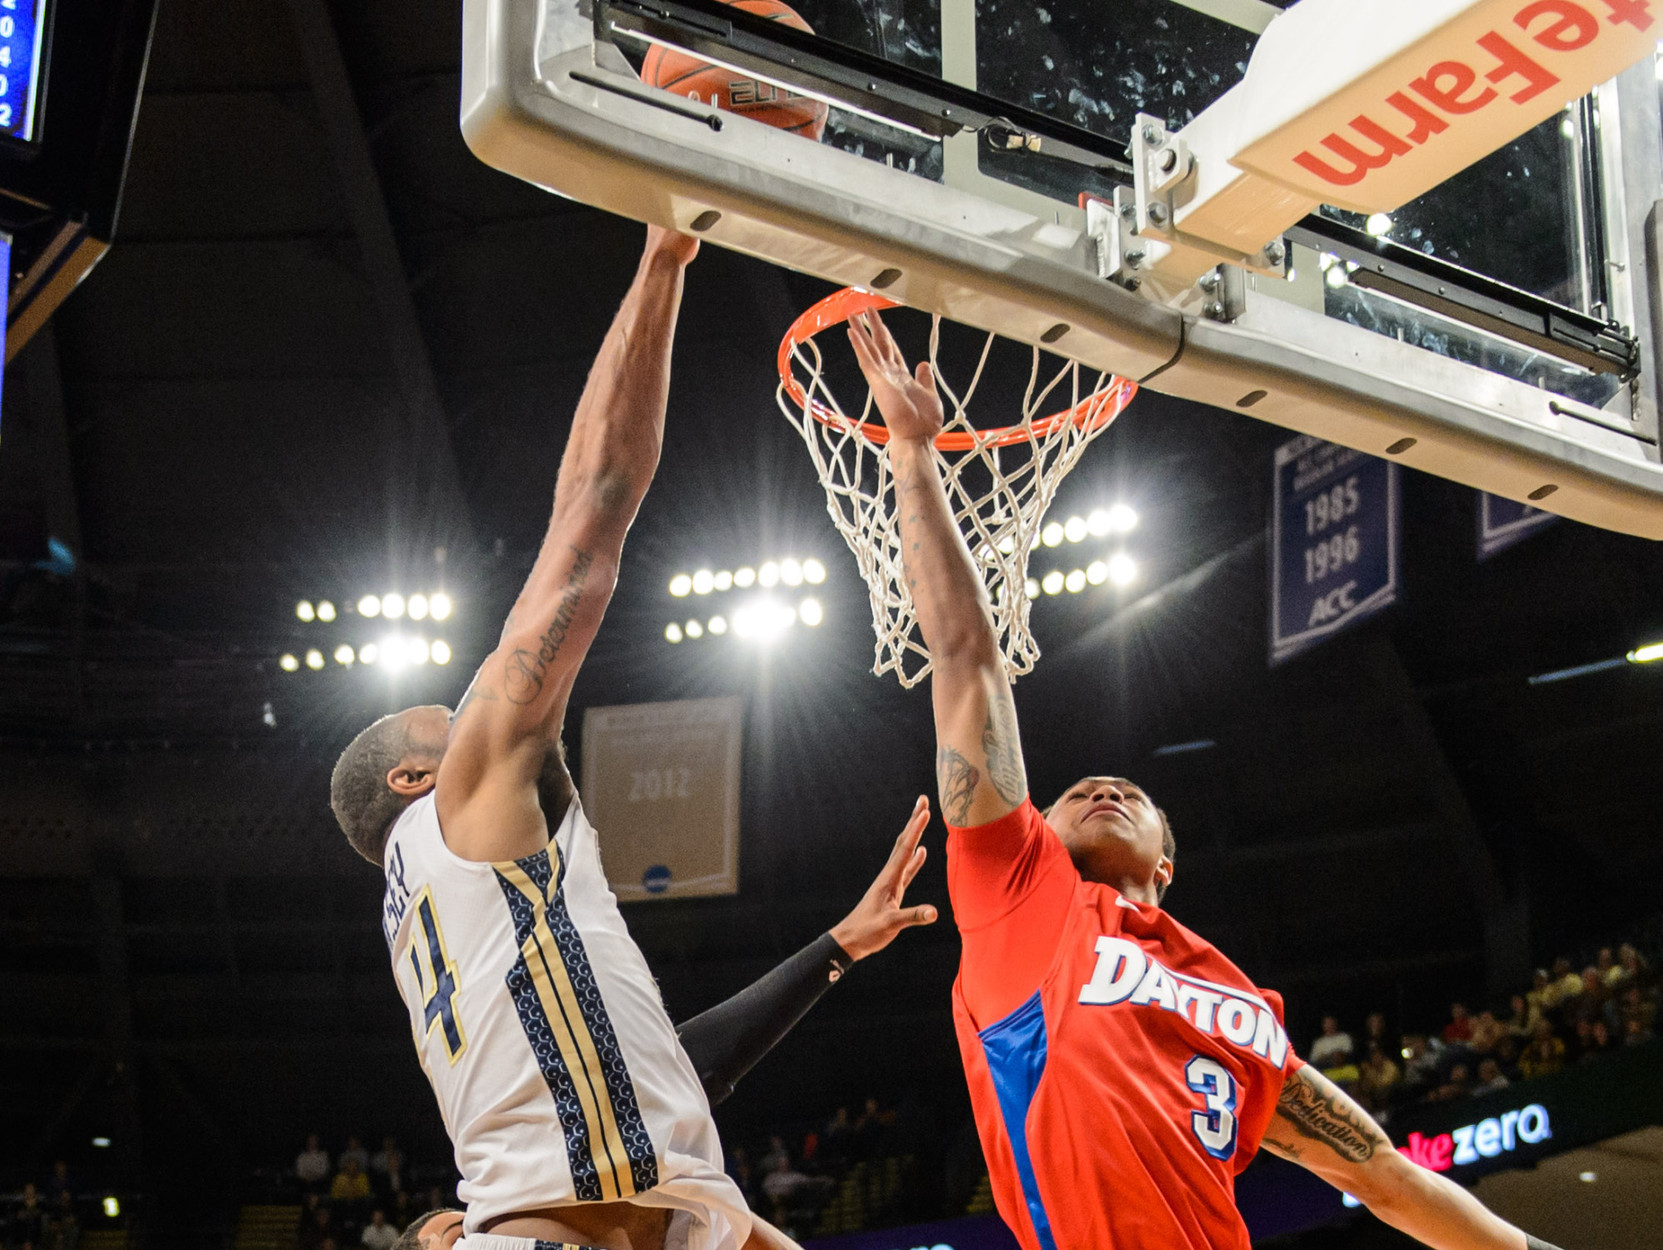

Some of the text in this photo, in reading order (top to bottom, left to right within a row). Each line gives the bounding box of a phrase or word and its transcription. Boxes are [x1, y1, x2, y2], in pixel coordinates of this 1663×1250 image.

[1305, 476, 1360, 535] 1985
[1305, 525, 1360, 584] 1996
[1308, 579, 1358, 628] ACC
[628, 768, 692, 801] 2012
[1078, 935, 1289, 1070] DAYTON
[1184, 1053, 1239, 1162] 3
